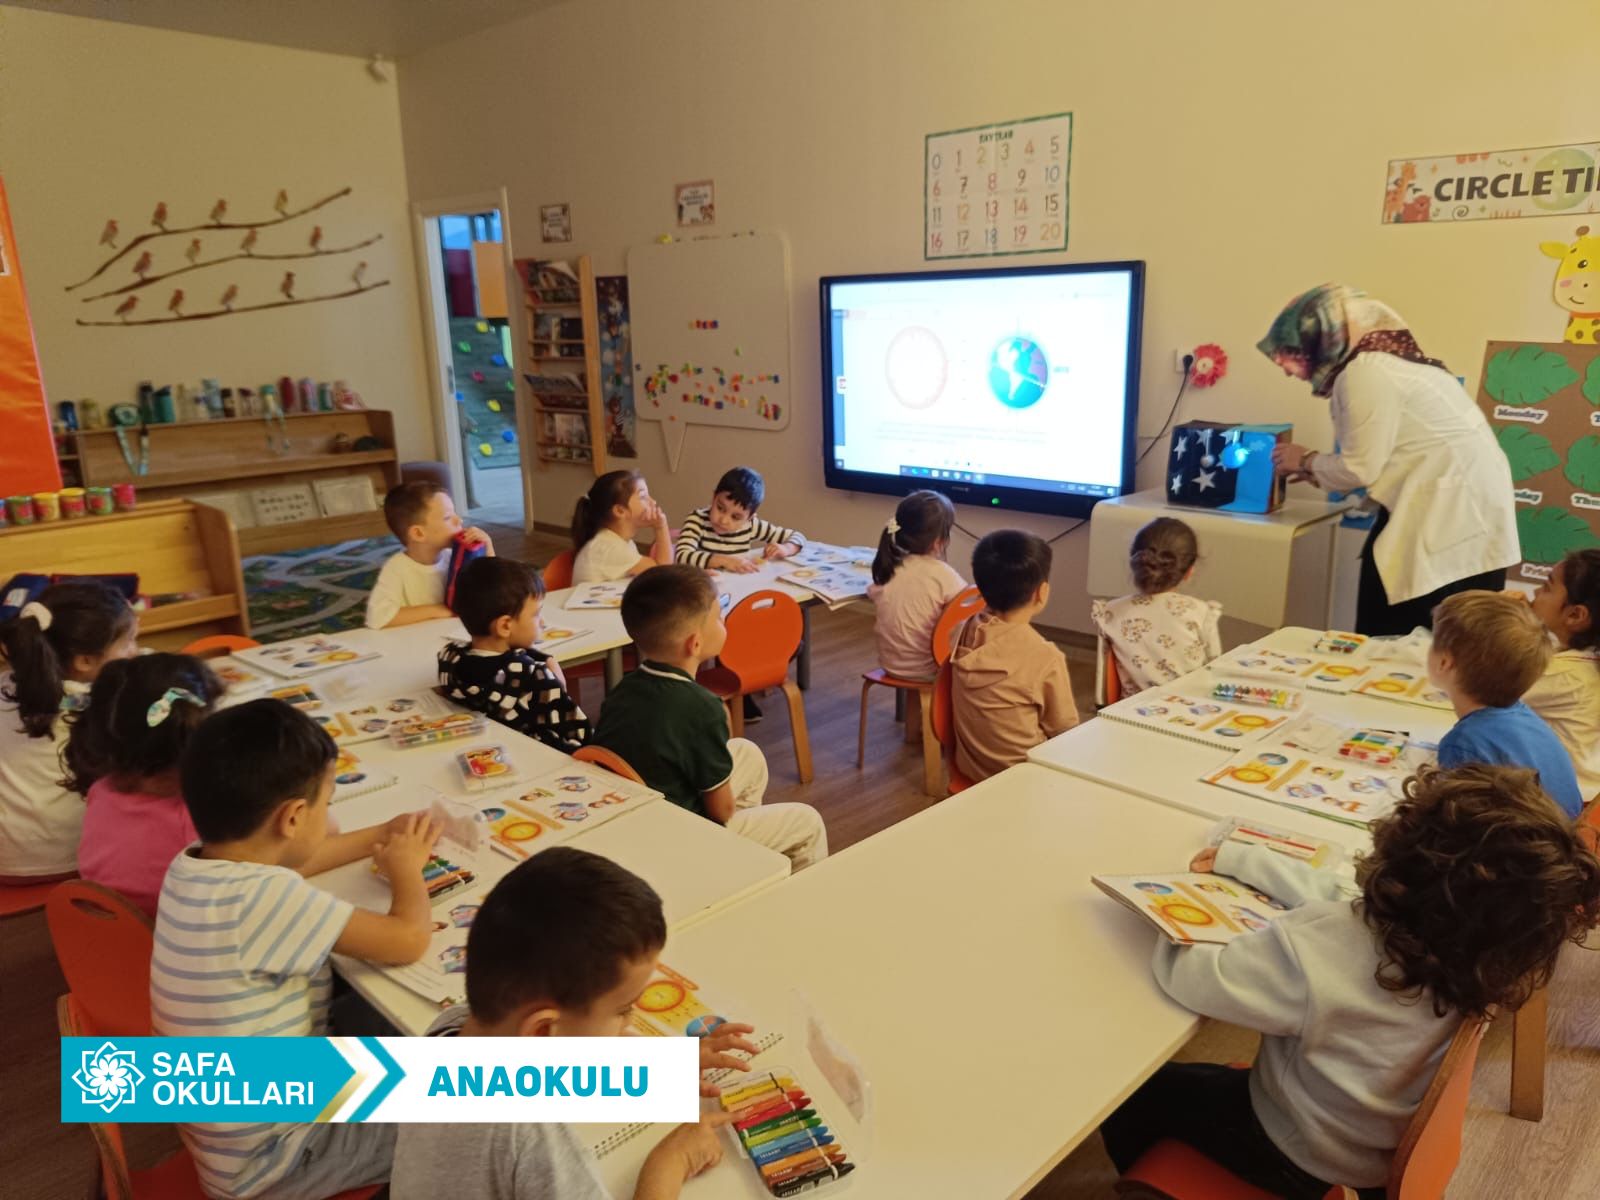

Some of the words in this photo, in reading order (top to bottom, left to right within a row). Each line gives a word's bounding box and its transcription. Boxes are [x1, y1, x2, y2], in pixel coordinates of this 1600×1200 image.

[932, 154, 941, 170] 0
[956, 150, 961, 165] 1
[976, 147, 987, 164] 2
[1000, 144, 1009, 160] 3
[1024, 140, 1035, 155] 4
[1050, 136, 1059, 154] 5
[932, 181, 941, 197] 6
[960, 176, 968, 193] 7
[988, 173, 997, 191] 8
[1017, 169, 1026, 186] 9
[1044, 165, 1060, 183] 10
[1434, 170, 1554, 202] CIRCLE
[1562, 166, 1600, 194] TI
[932, 207, 941, 222] 11
[957, 203, 970, 221] 12
[985, 200, 998, 218] 13
[1014, 198, 1028, 216] 14
[1044, 194, 1059, 212] 15
[931, 233, 943, 248] 16
[957, 230, 969, 246] 17
[985, 228, 998, 245] 18
[1014, 225, 1027, 242] 19
[1040, 223, 1061, 241] 20
[1497, 408, 1545, 420] Monday
